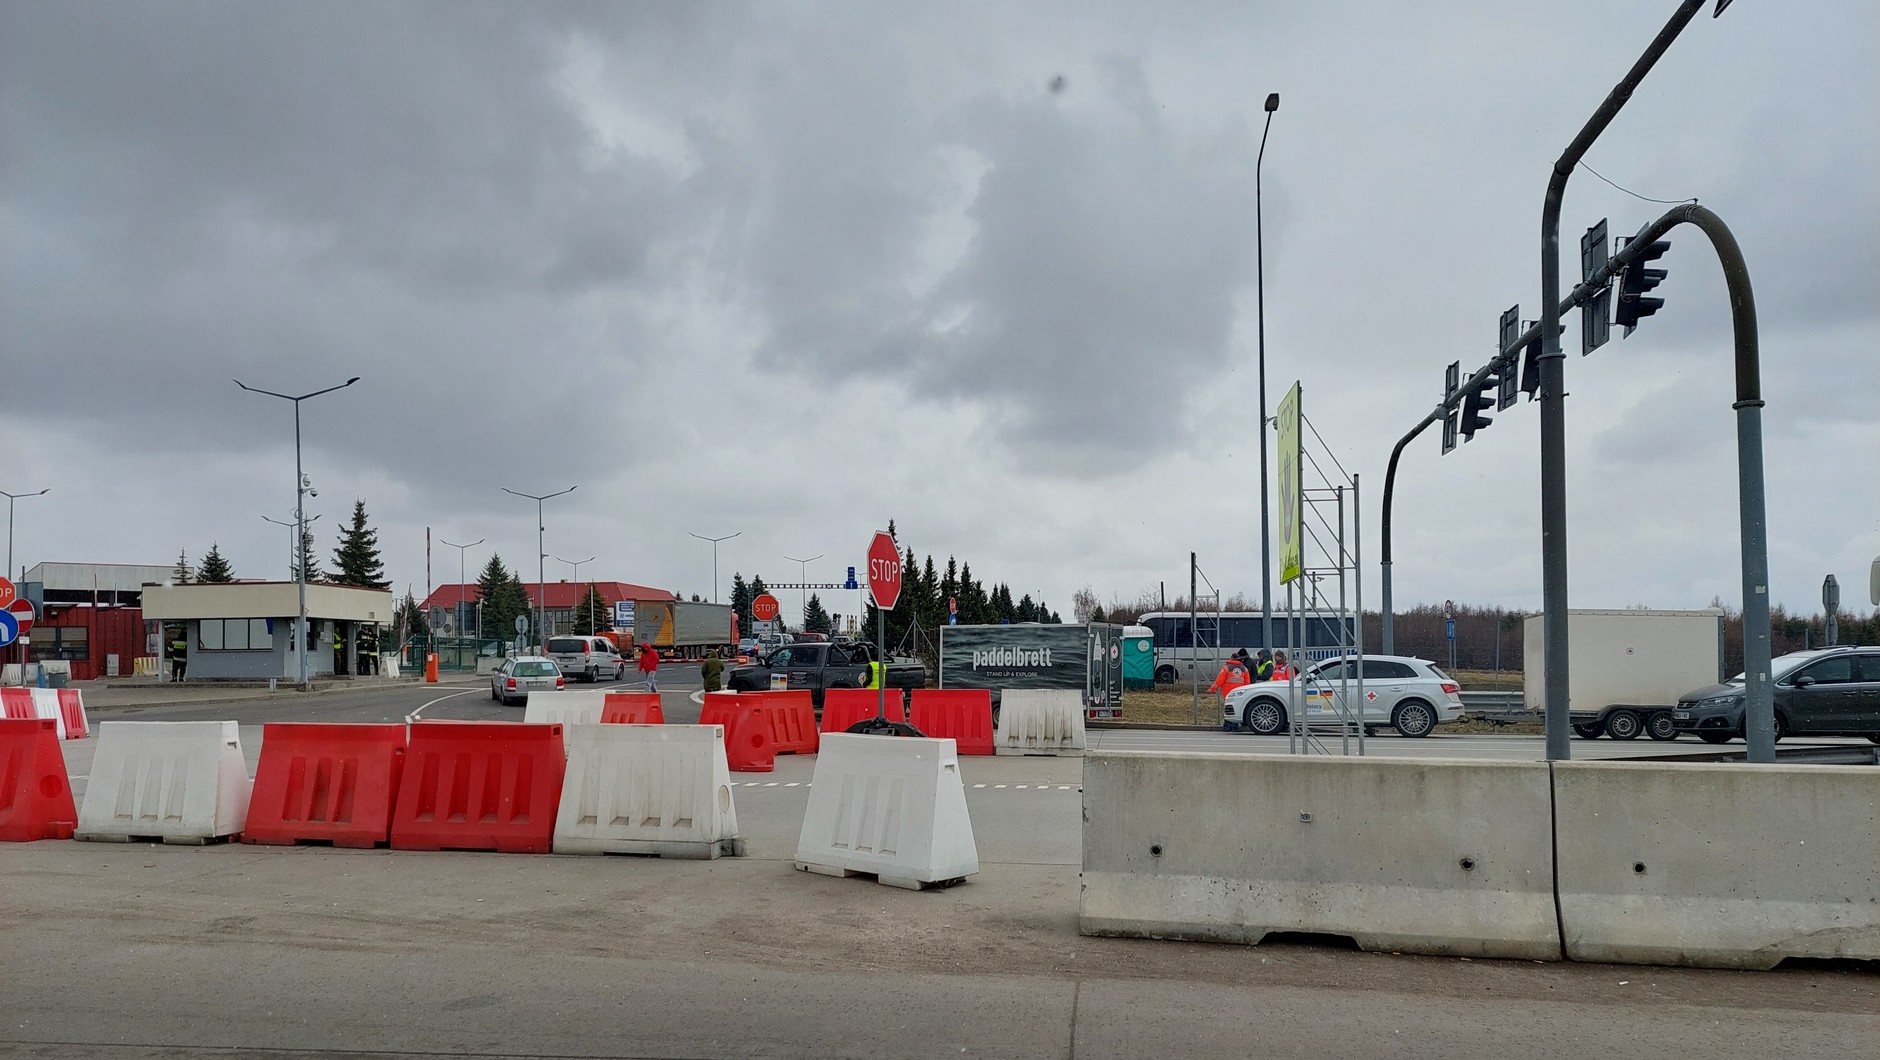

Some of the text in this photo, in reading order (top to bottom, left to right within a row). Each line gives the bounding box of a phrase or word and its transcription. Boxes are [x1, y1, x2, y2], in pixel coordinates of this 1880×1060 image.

[1281, 399, 1293, 440] STOP
[872, 558, 898, 582] STOP
[755, 604, 776, 612] STOP
[973, 646, 1052, 671] paddelbrett
